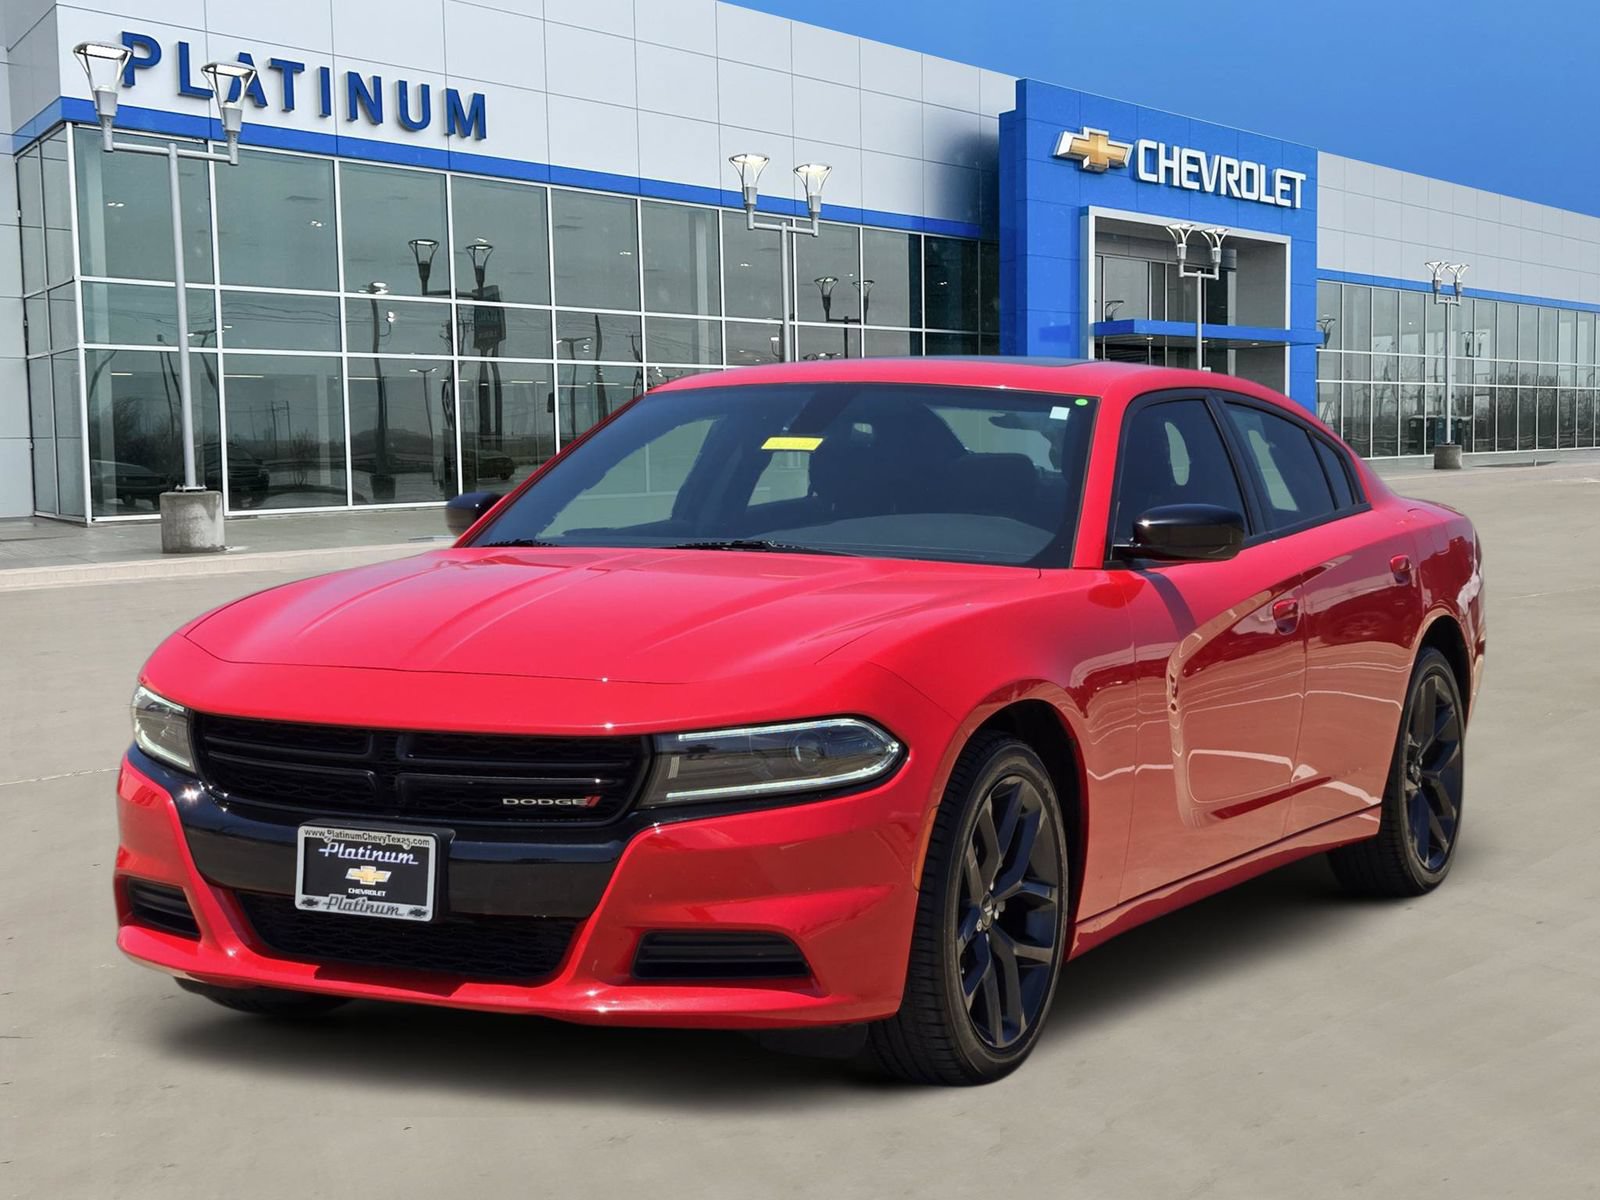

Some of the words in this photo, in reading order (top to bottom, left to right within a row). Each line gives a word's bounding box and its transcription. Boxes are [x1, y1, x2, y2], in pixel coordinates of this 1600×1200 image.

[121, 31, 487, 140] PLATINUM
[1137, 138, 1306, 209] CHEVROLET
[502, 798, 589, 806] DODGE
[318, 842, 419, 865] Platinum
[348, 888, 387, 897] CHEVROLET
[323, 895, 406, 917] Platinum
